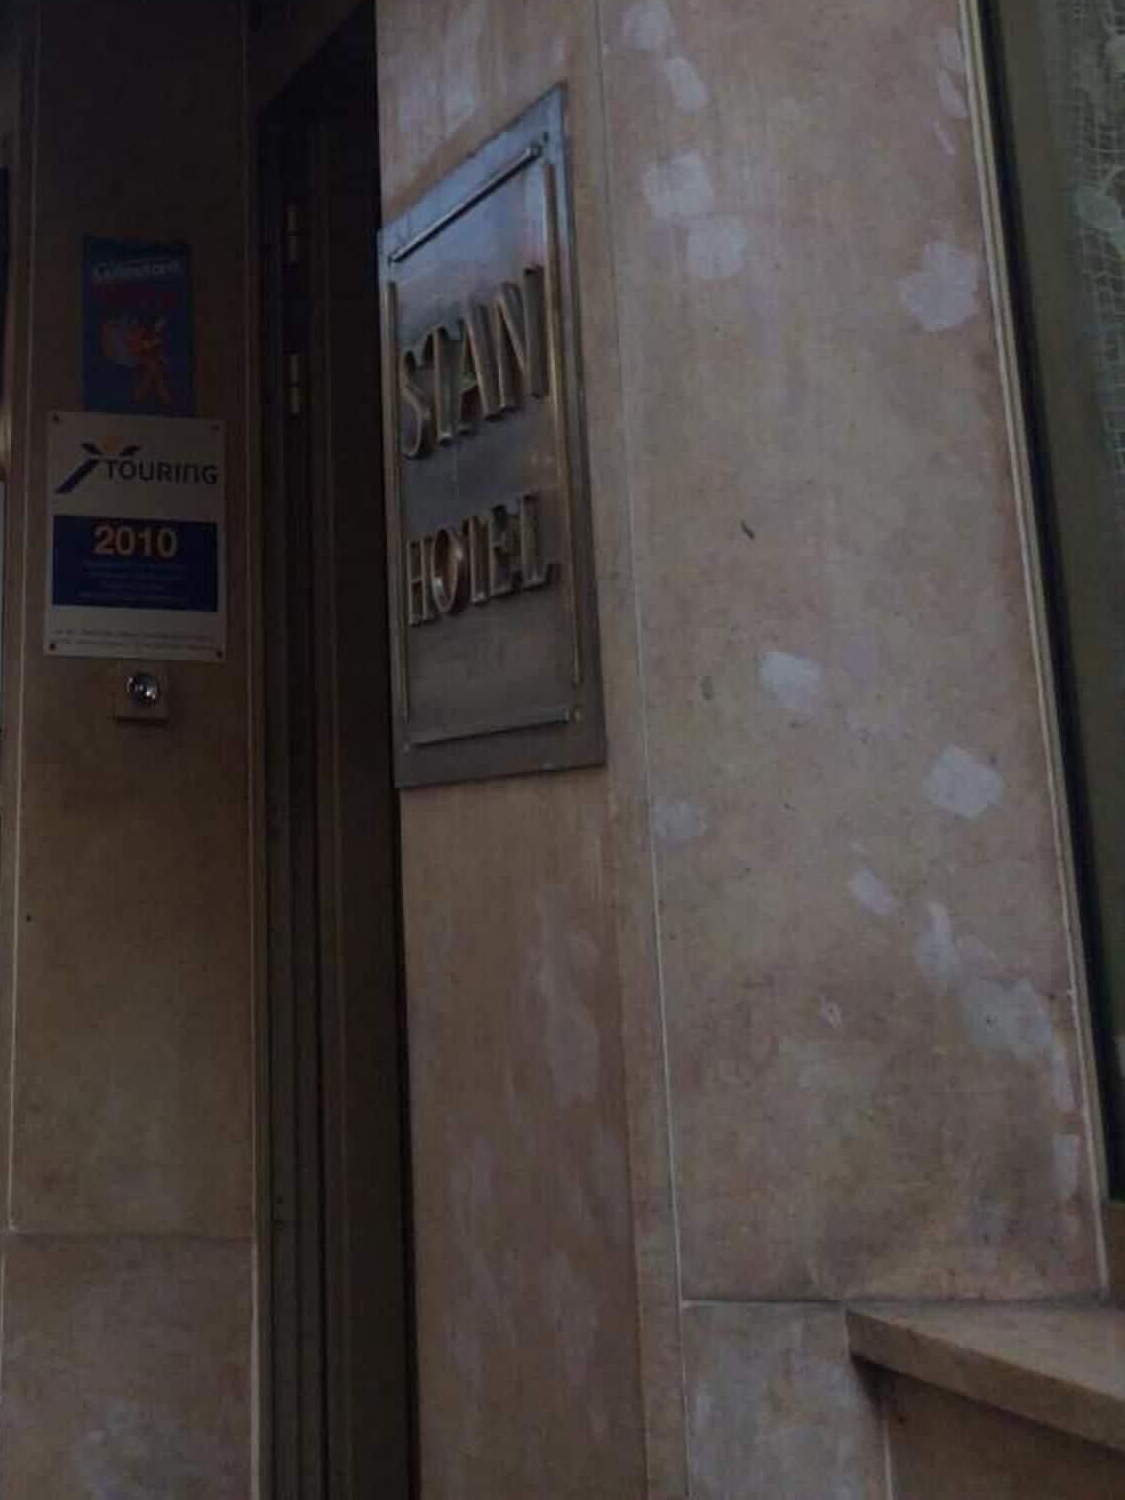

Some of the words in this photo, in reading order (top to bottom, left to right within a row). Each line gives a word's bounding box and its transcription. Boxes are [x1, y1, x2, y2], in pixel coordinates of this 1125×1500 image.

[401, 267, 550, 459] STAN
[104, 457, 219, 486] TOURING
[93, 523, 179, 559] 2010
[407, 493, 555, 627] HOTEL
